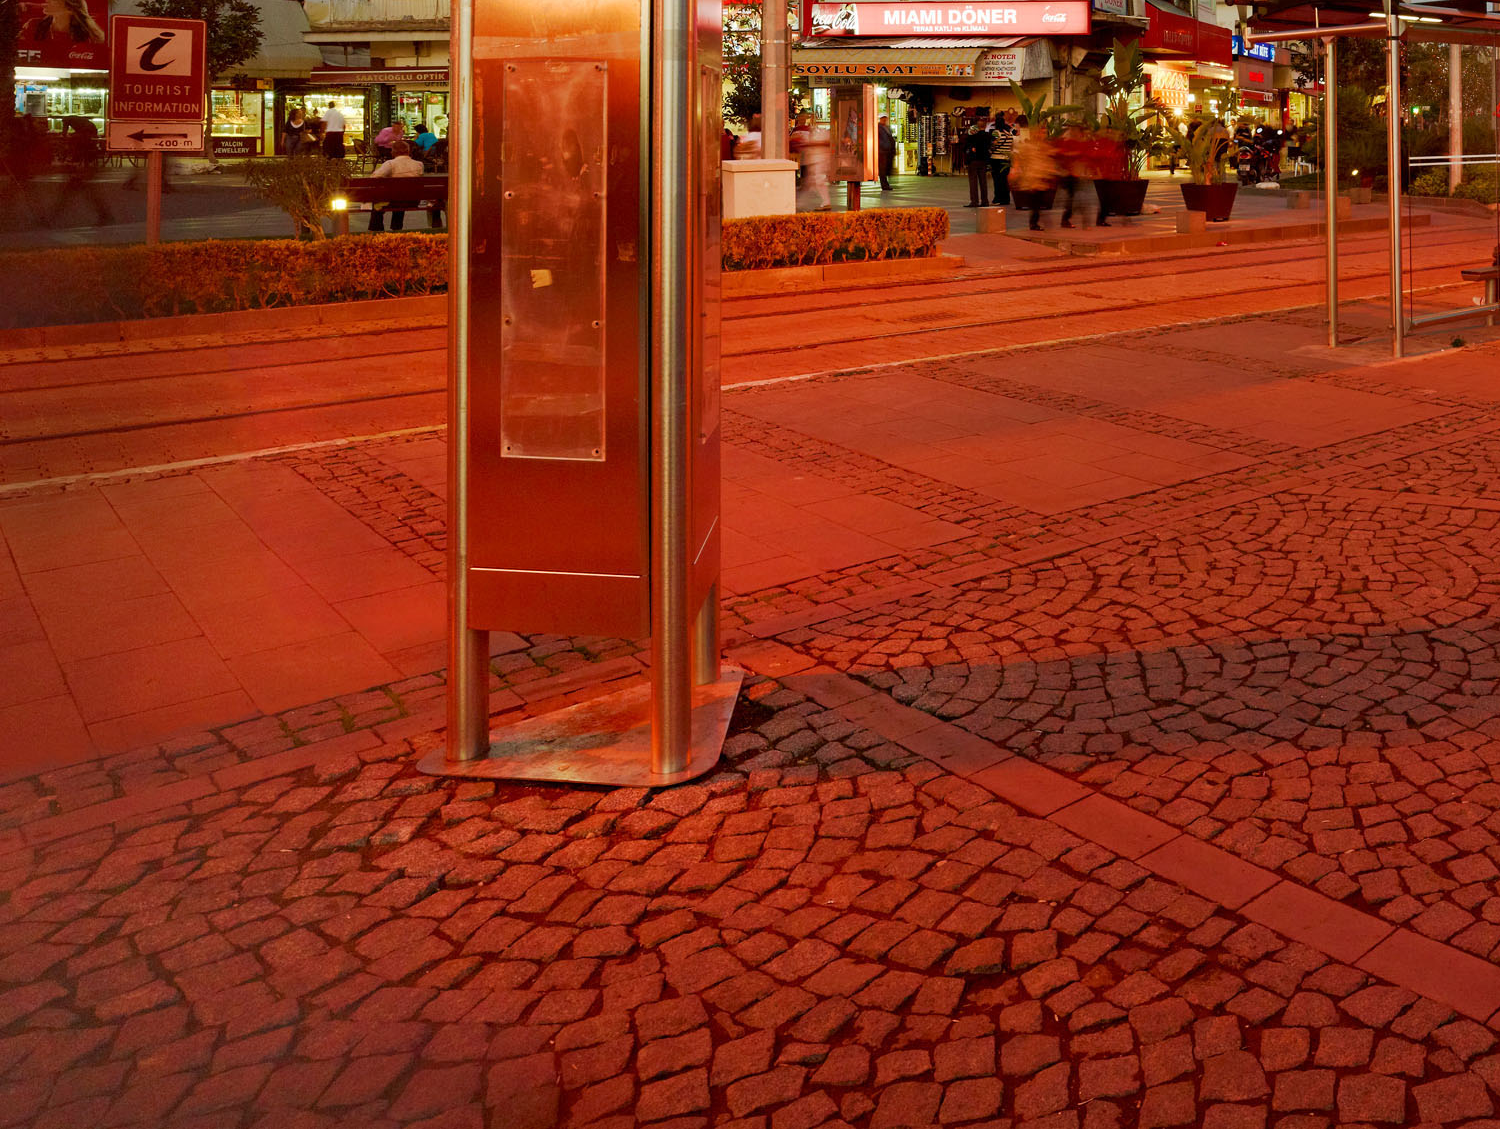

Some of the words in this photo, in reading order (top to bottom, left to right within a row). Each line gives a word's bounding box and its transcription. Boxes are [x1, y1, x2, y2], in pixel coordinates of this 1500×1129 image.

[949, 6, 1017, 24] DÖNER
[795, 66, 857, 74] SOYLU
[866, 65, 917, 74] SAAT
[124, 84, 191, 96] TOURIST
[115, 101, 200, 114] INFORMATION
